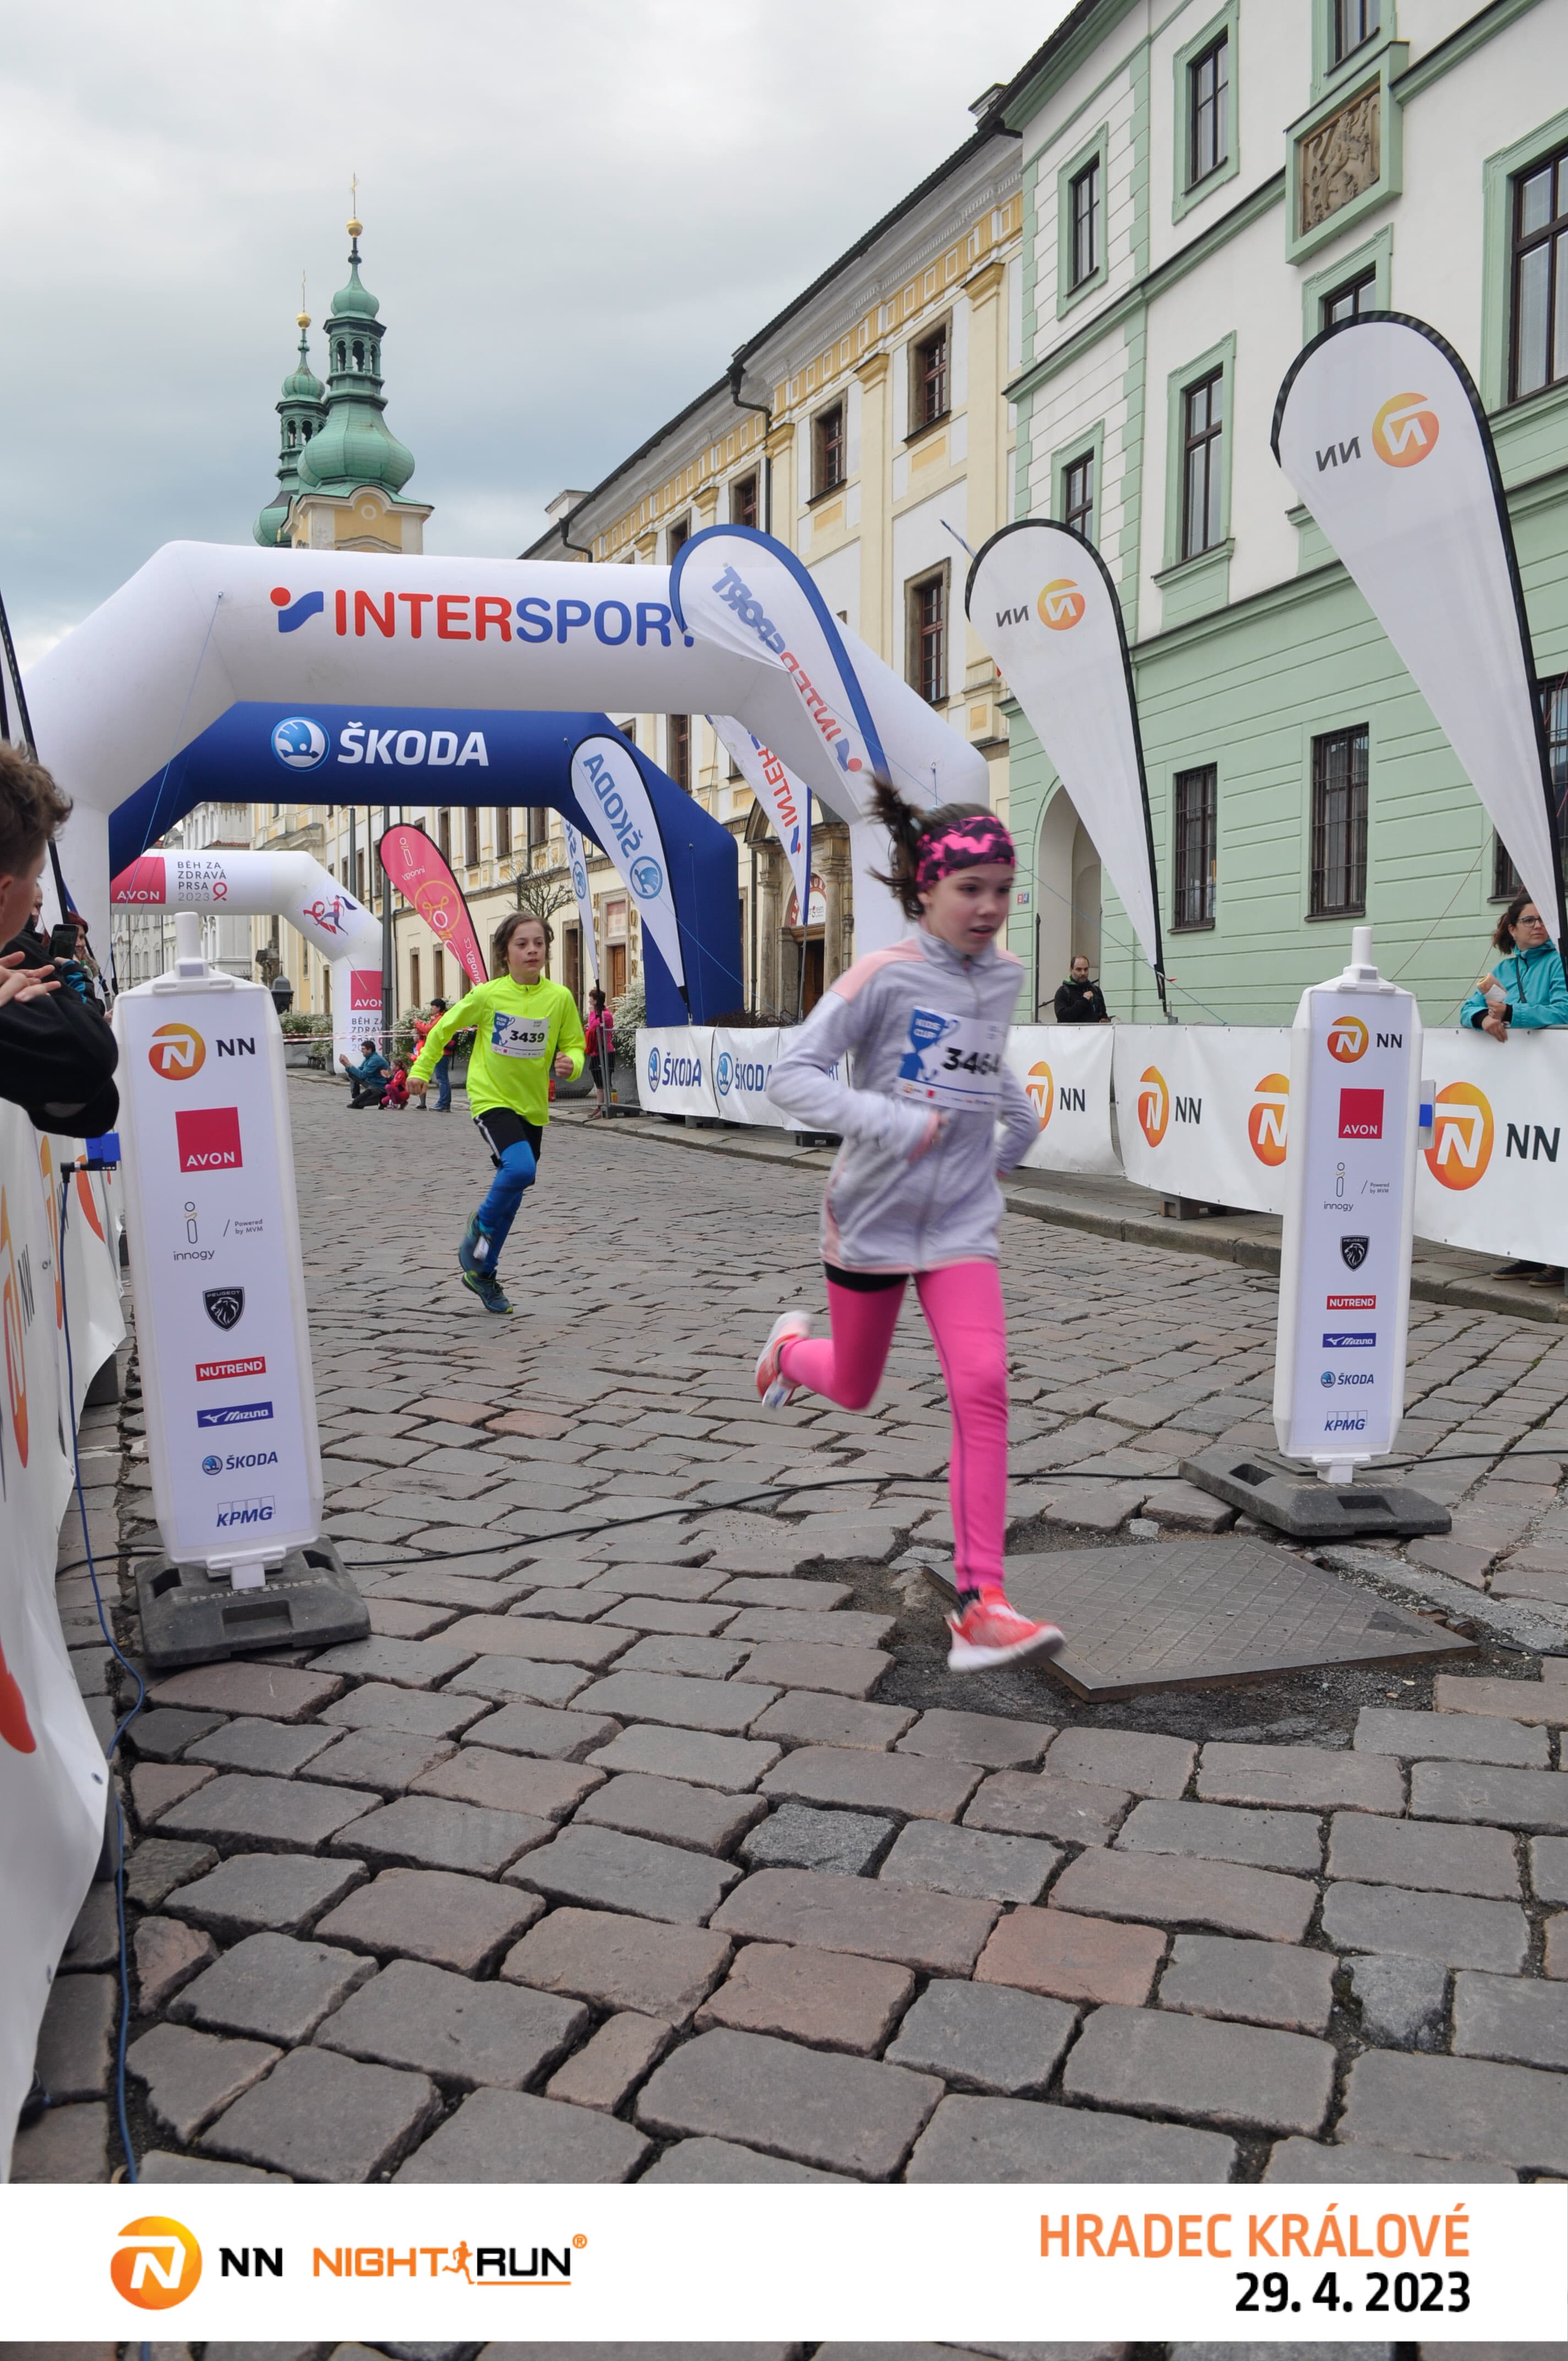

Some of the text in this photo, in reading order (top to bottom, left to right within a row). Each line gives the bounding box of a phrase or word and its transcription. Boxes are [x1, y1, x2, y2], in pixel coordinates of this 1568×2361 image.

[335, 590, 694, 648] INTERSPOR
[337, 722, 489, 766] ŠKODA
[177, 861, 200, 869] BĚH
[178, 869, 226, 879] ZDRAVÁ
[178, 882, 208, 890] PRSA
[117, 890, 160, 900] AVON
[178, 893, 210, 901] 2023
[509, 1030, 545, 1043] 3439
[1376, 1033, 1402, 1048] NN
[215, 1037, 255, 1057] NN
[662, 1052, 701, 1087] ŠKODA
[1060, 1087, 1085, 1112] NN
[1175, 1096, 1202, 1124] NN
[1343, 1124, 1378, 1135] AVON
[1506, 1123, 1561, 1162] NN
[186, 1151, 235, 1167] AVON
[1324, 1201, 1354, 1211] innogy
[235, 1218, 263, 1227] Powered
[173, 1250, 215, 1261] innogy
[1330, 1298, 1374, 1307] NUTREND
[200, 1361, 263, 1377] NUTREND
[1337, 1373, 1374, 1385] ŠKODA
[1324, 1418, 1366, 1431] KPMG
[226, 1451, 278, 1470] ŠKODA
[216, 1506, 273, 1527] KPMG
